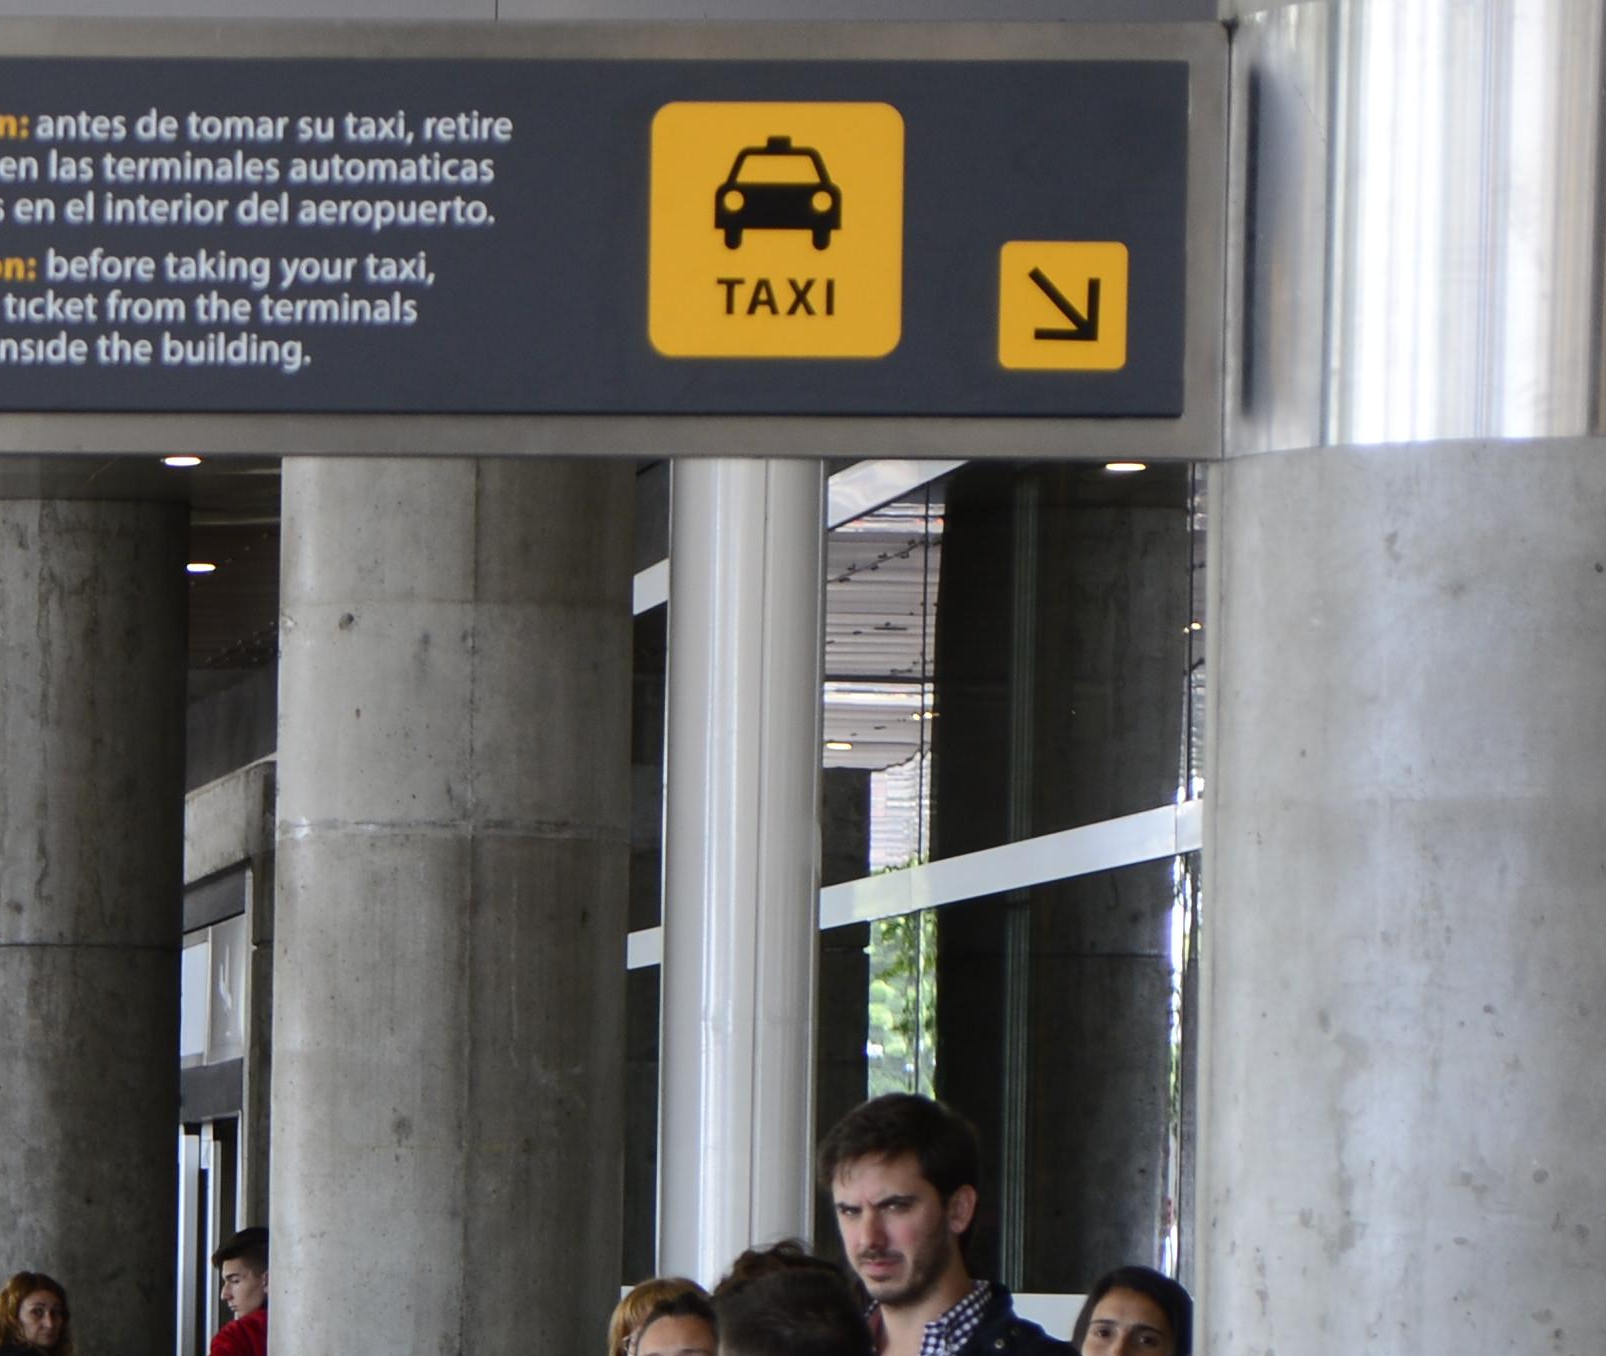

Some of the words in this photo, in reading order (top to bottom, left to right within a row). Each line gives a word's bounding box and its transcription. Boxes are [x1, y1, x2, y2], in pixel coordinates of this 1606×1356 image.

[36, 111, 127, 141] antes
[136, 108, 178, 141] de
[188, 111, 289, 142] tomar
[298, 116, 335, 142] su
[344, 110, 414, 145] taxi,
[424, 110, 513, 142] retire
[49, 149, 94, 182] las
[103, 150, 280, 183] terminales
[289, 152, 495, 184] automaticas
[14, 198, 56, 223] en
[64, 190, 95, 224] el
[104, 191, 229, 224] interior
[237, 191, 289, 225] del
[298, 196, 495, 232] aeropuerto.
[46, 247, 156, 282] before
[164, 249, 271, 291] taking
[280, 257, 358, 290] your
[365, 252, 435, 286] taxi,
[106, 289, 186, 323] from
[195, 290, 252, 324] the
[260, 291, 418, 325] terminals
[716, 277, 836, 317] TAXI
[97, 331, 153, 364] the
[162, 331, 311, 374] building.
